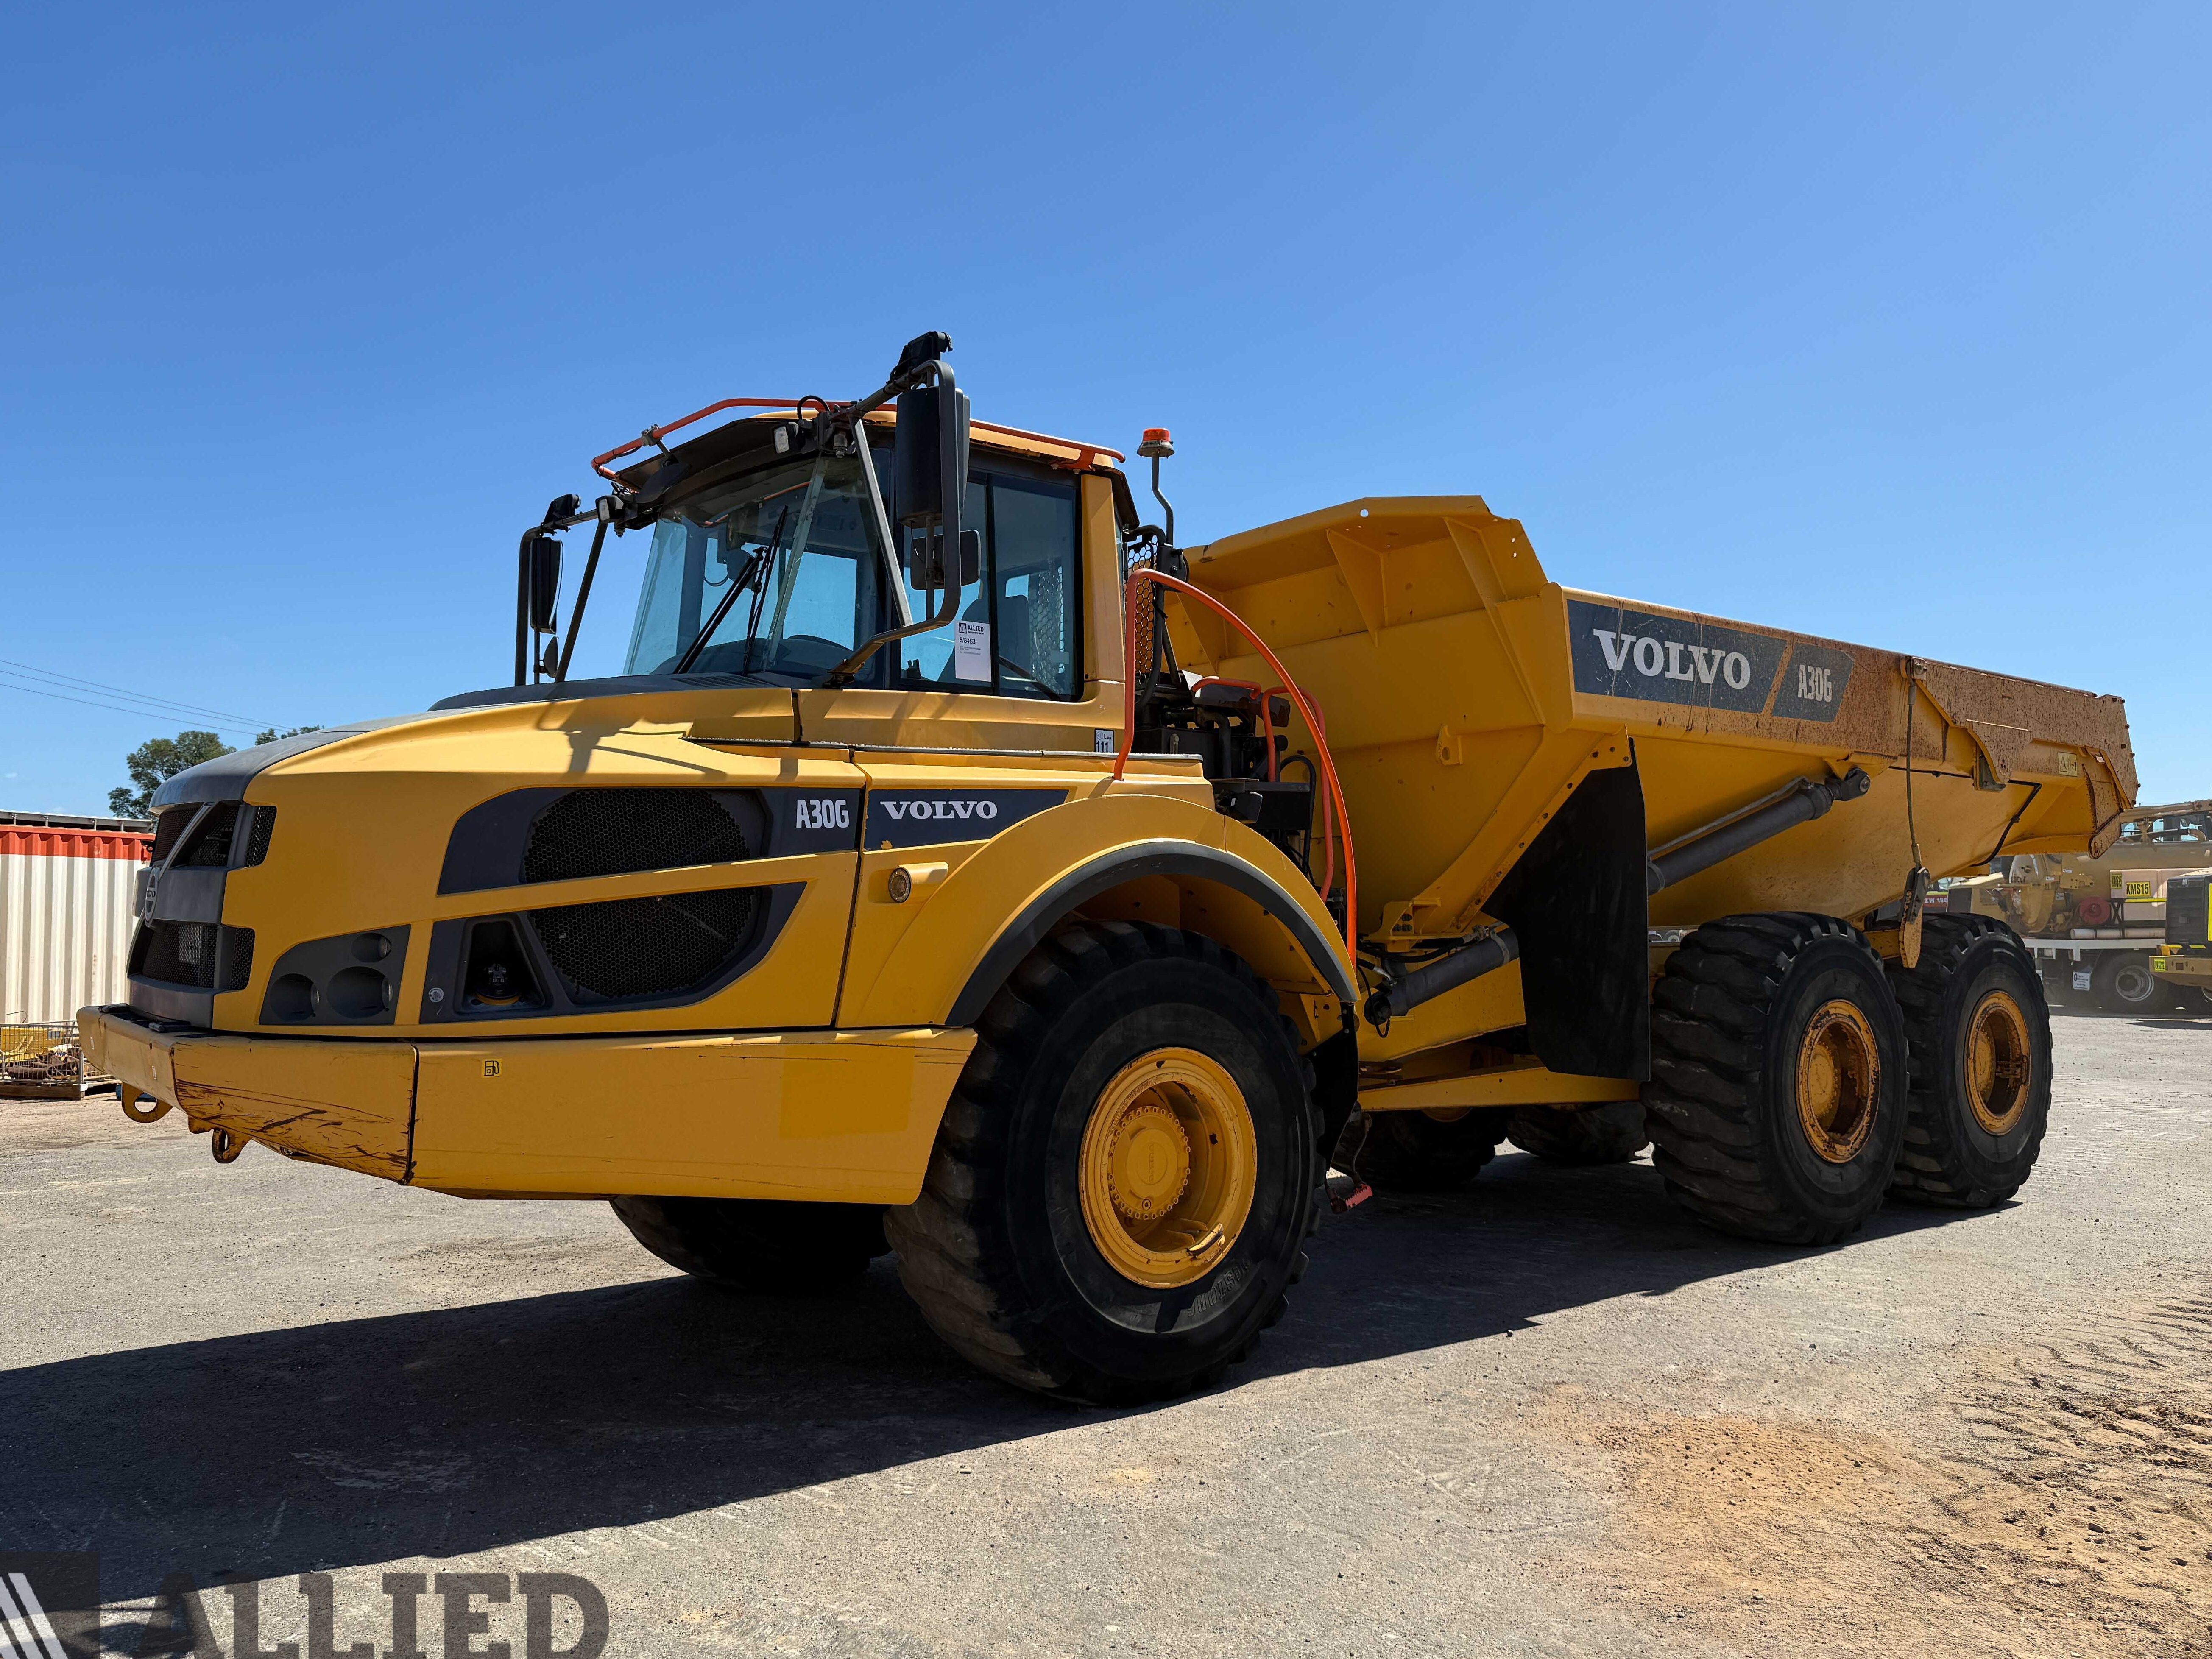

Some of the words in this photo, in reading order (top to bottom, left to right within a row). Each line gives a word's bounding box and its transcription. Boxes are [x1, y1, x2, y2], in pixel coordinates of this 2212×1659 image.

[1593, 629, 1751, 689] VOLVO
[1798, 664, 1832, 703] A30G
[1096, 741, 1108, 753] 111
[796, 799, 849, 828] A30G
[880, 800, 997, 819] VOLVO
